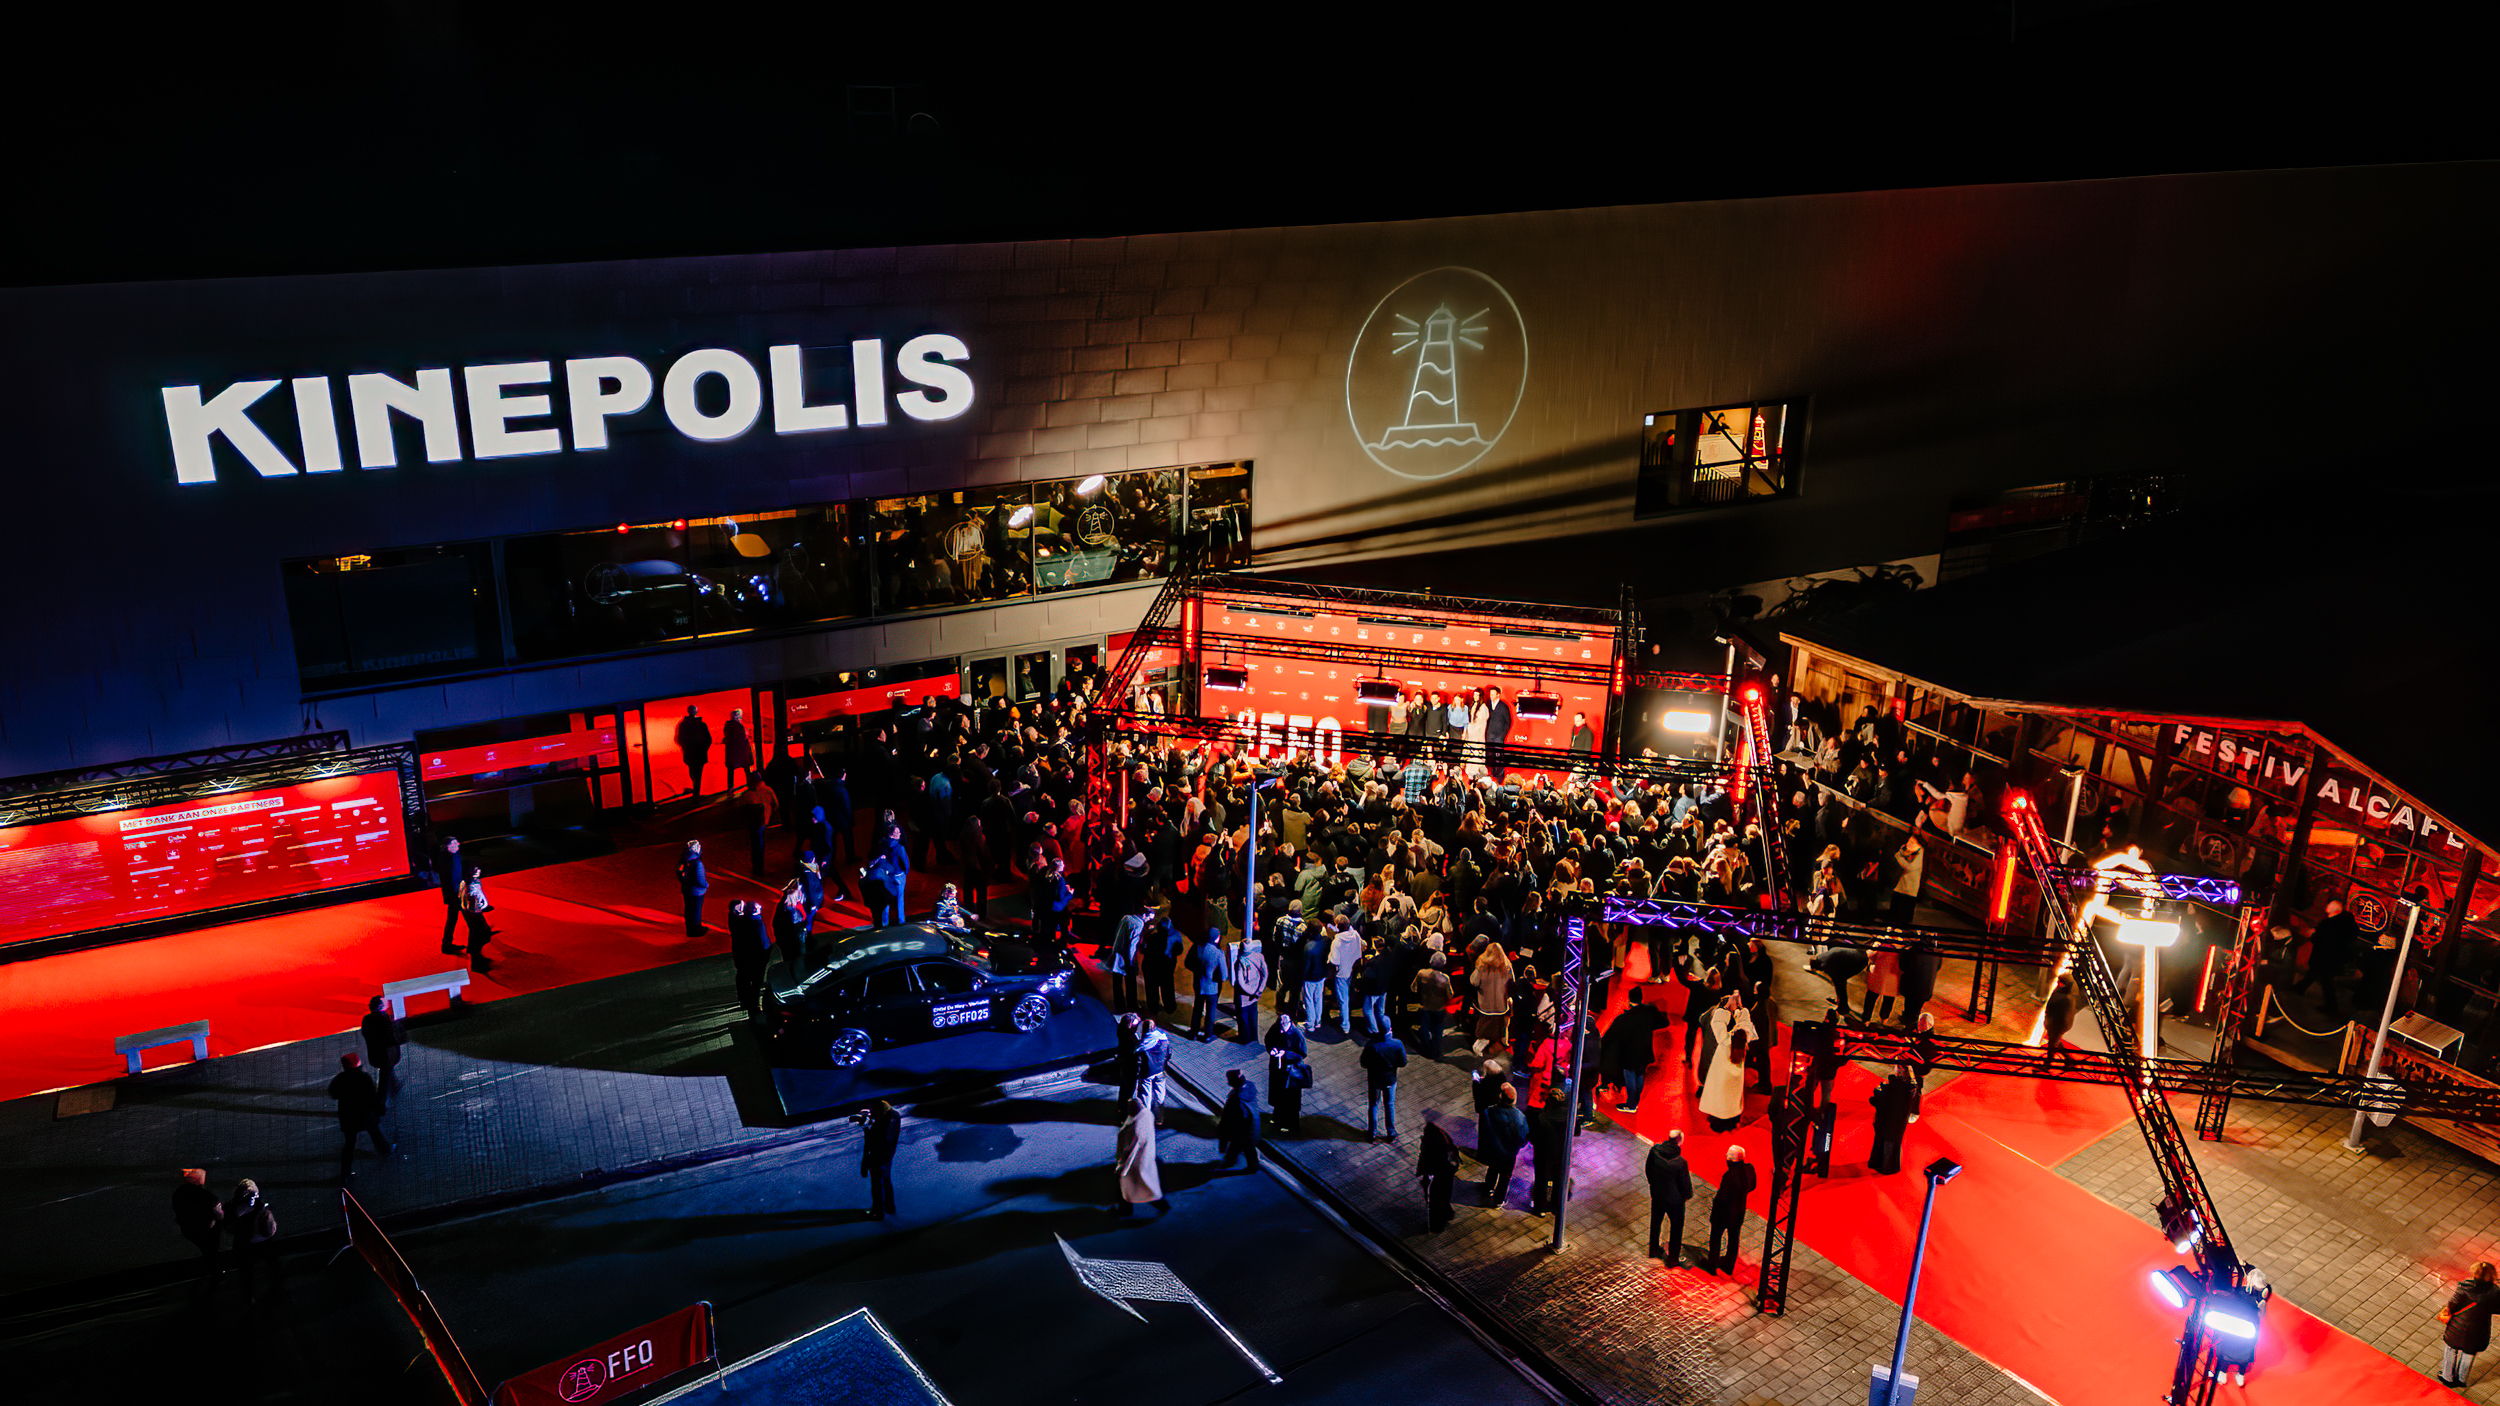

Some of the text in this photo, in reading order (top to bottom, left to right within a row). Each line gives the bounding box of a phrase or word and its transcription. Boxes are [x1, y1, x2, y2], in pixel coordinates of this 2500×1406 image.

[162, 334, 974, 484] KINEPOLIS
[122, 820, 143, 830] MET
[145, 815, 175, 826] DANK
[177, 811, 200, 821] AAN
[201, 806, 231, 817] ONZE
[230, 798, 281, 813] PARTNERS
[607, 1339, 653, 1378] FFO
